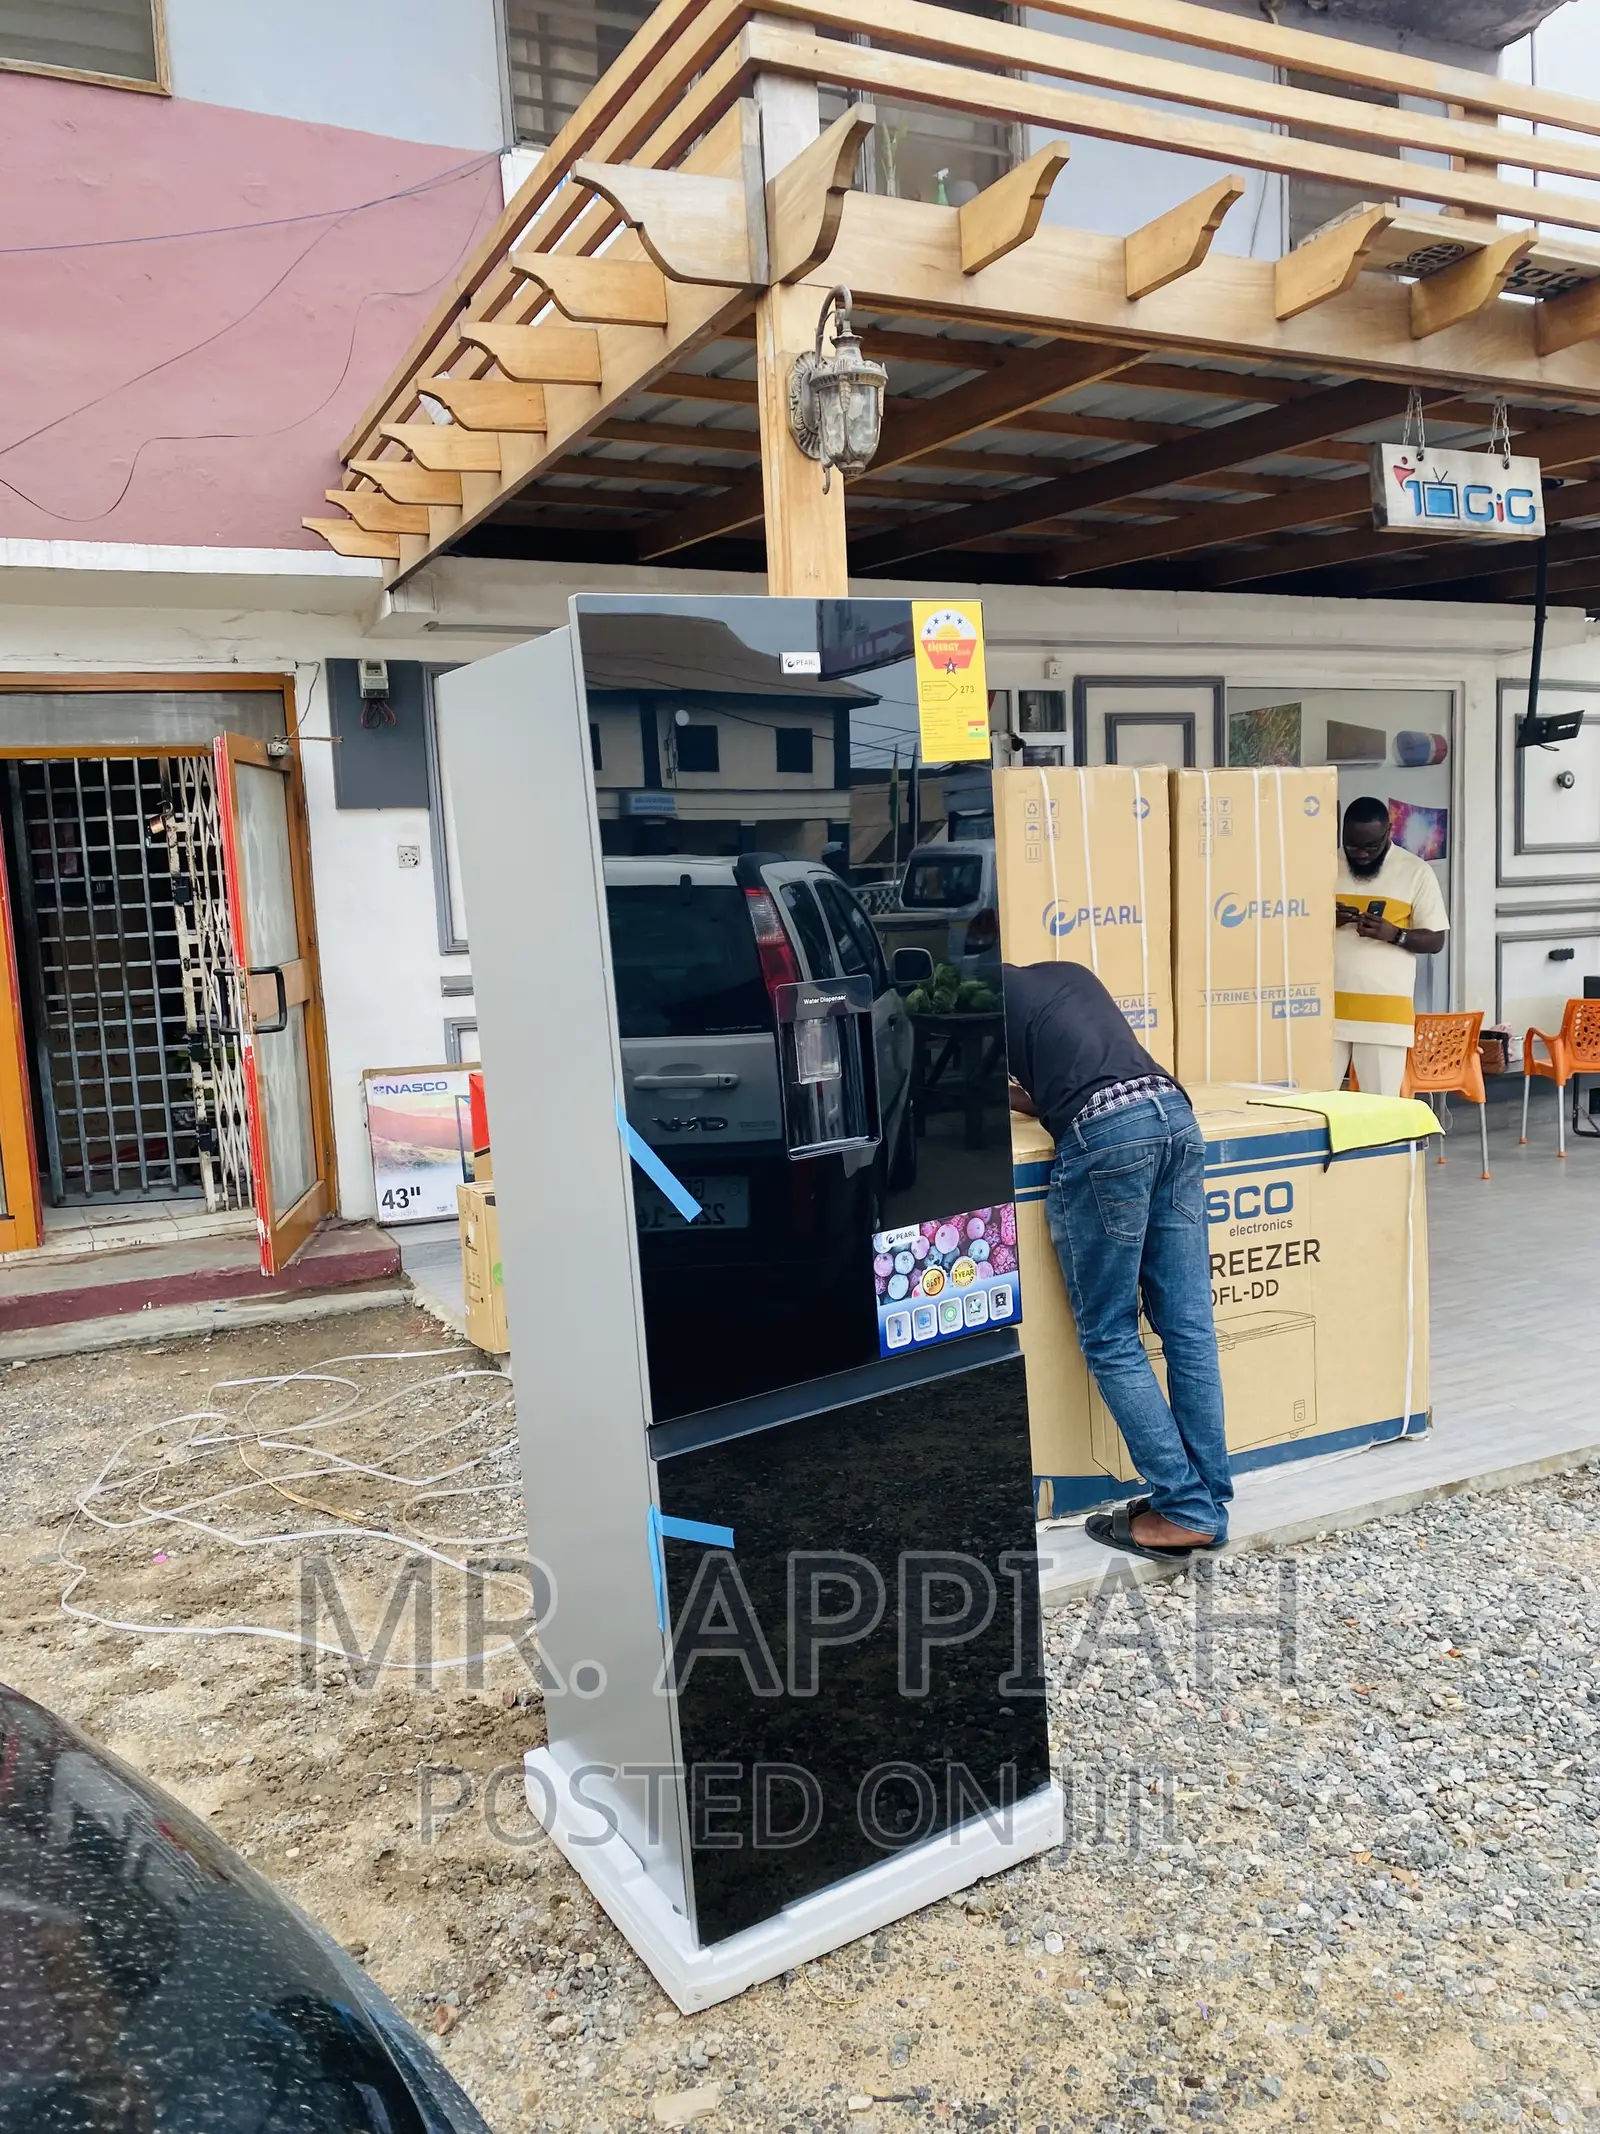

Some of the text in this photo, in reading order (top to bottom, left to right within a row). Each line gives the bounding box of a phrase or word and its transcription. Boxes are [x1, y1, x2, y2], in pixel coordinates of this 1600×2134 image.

[960, 686, 975, 694] 273
[1222, 820, 1229, 830] 2
[1248, 898, 1311, 919] PEARL
[1077, 904, 1143, 928] PEARL
[820, 995, 847, 1003] Dispenser
[1115, 996, 1152, 1009] ICALE
[385, 1081, 448, 1095] NASCO
[382, 1186, 421, 1210] 43"
[1205, 1181, 1294, 1225] SCO
[1229, 1219, 1294, 1237] electronics
[896, 1230, 916, 1241] PEARL
[1209, 1239, 1321, 1280] REEZER
[958, 1269, 975, 1278] YEAR
